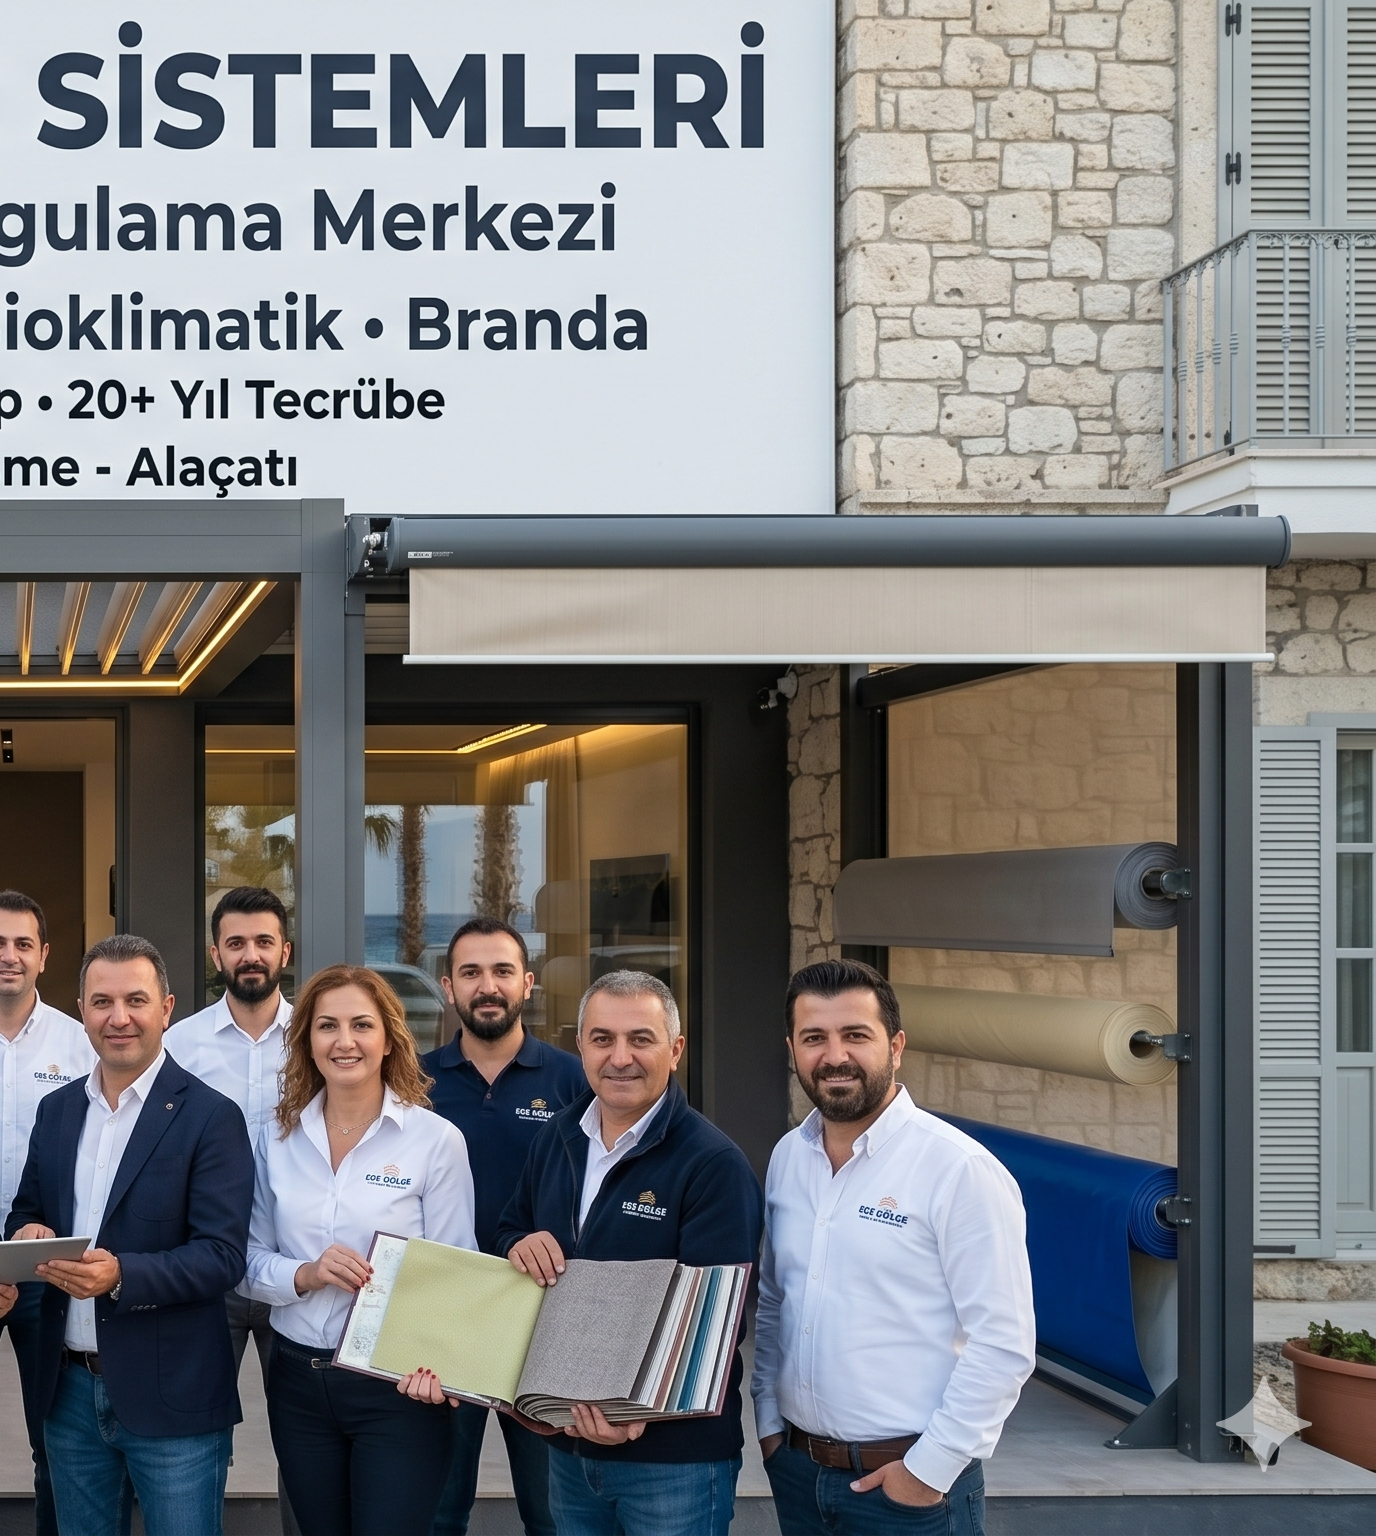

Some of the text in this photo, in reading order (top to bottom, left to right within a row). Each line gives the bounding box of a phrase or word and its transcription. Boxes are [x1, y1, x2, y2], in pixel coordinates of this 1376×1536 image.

[36, 20, 766, 151] SİSTEMLERİ
[313, 181, 617, 253] Merkezi
[408, 294, 648, 351] Branda
[67, 379, 155, 421] 20+
[170, 377, 229, 420] Yıl
[244, 377, 445, 420] Tecrübe
[125, 444, 298, 499] Alaçatı
